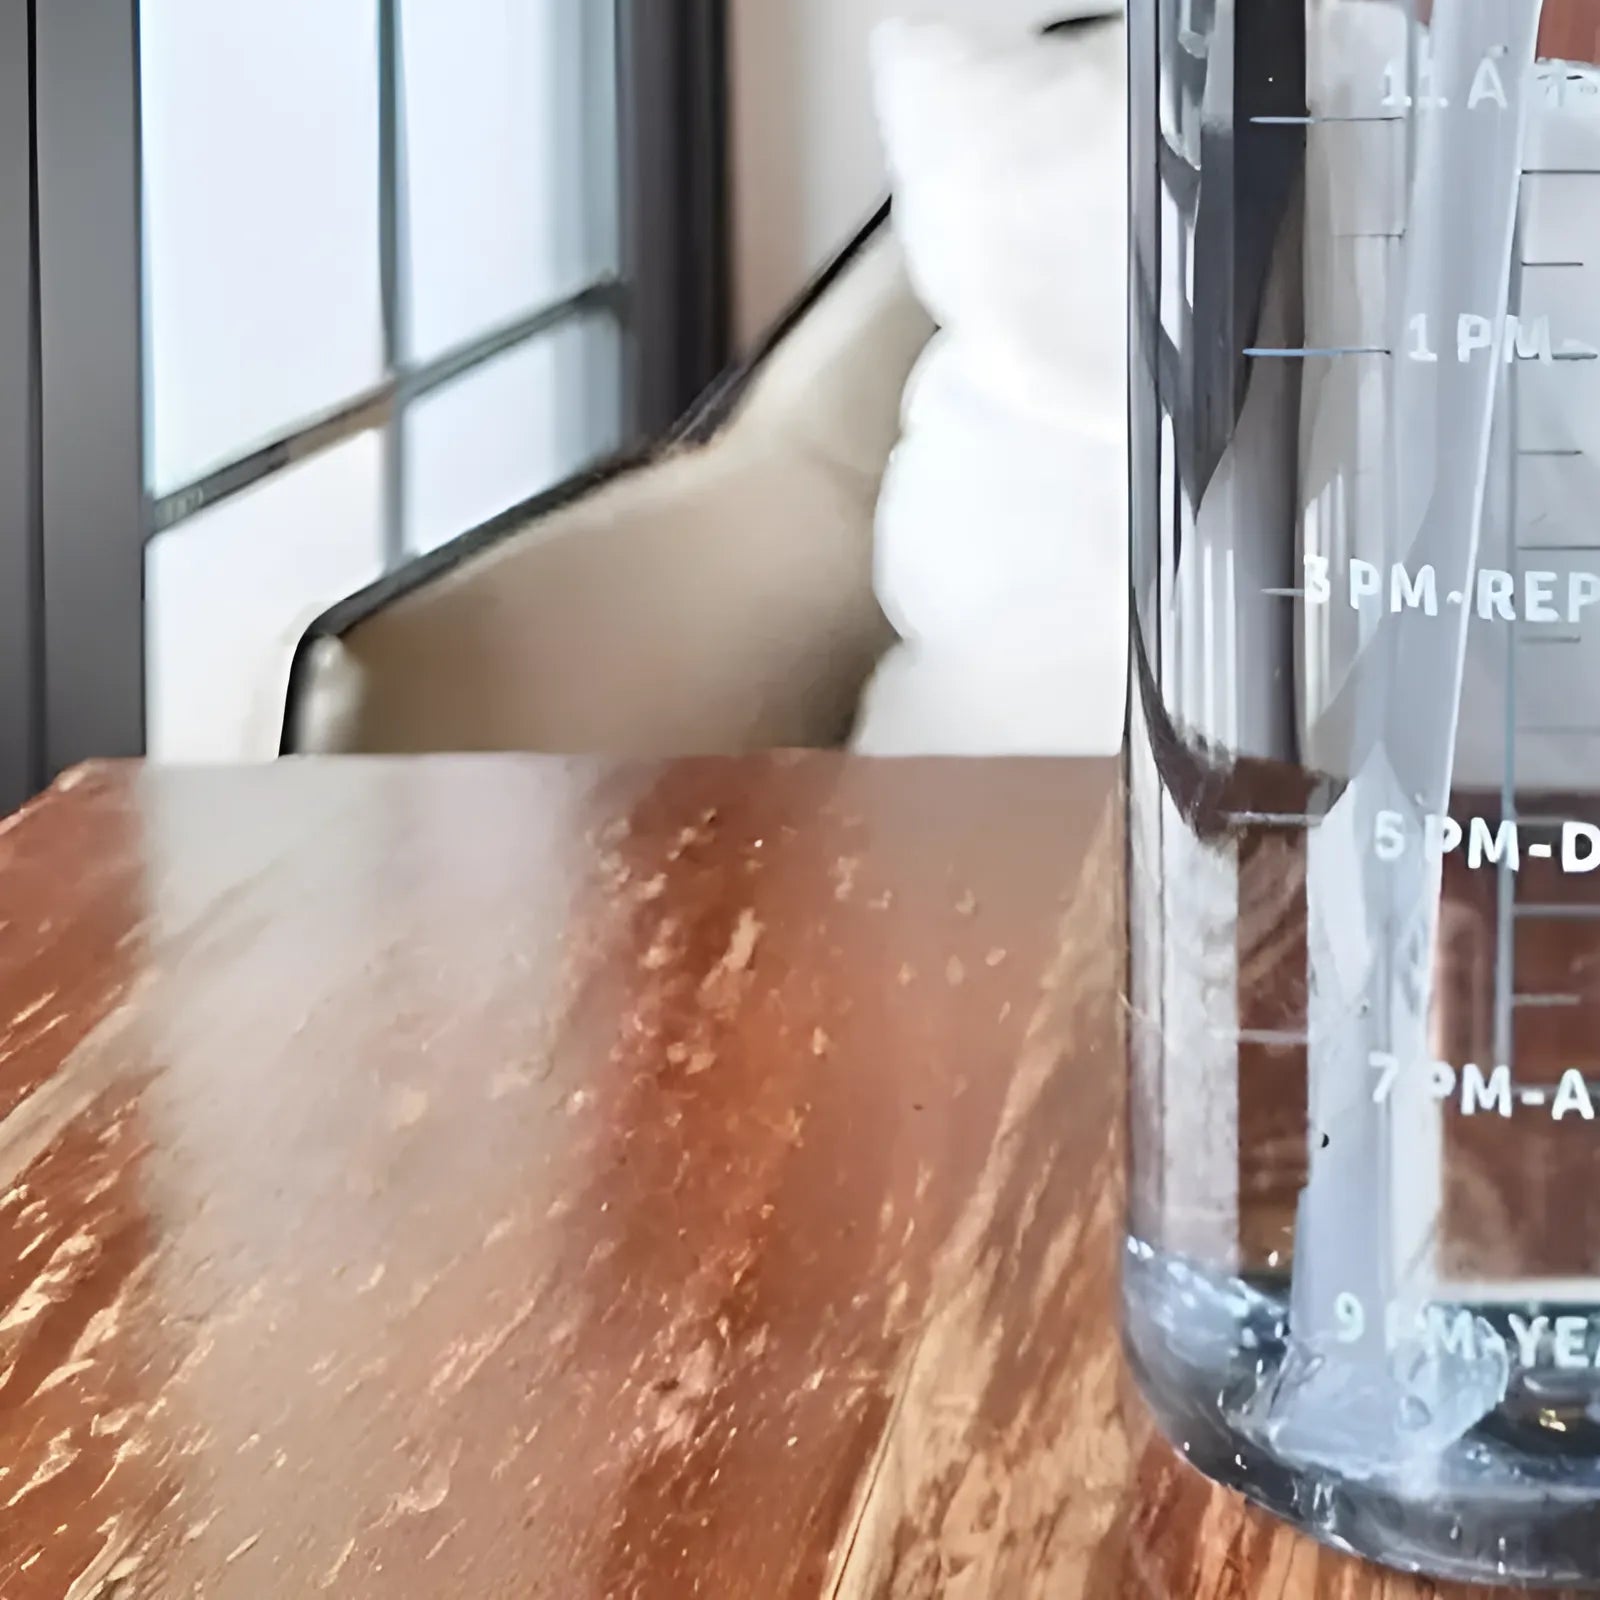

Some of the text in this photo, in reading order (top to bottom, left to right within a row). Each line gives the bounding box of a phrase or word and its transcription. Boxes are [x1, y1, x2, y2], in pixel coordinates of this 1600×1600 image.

[1406, 312, 1439, 363] 1
[1368, 1050, 1400, 1103] 7
[1335, 1291, 1365, 1344] 9
